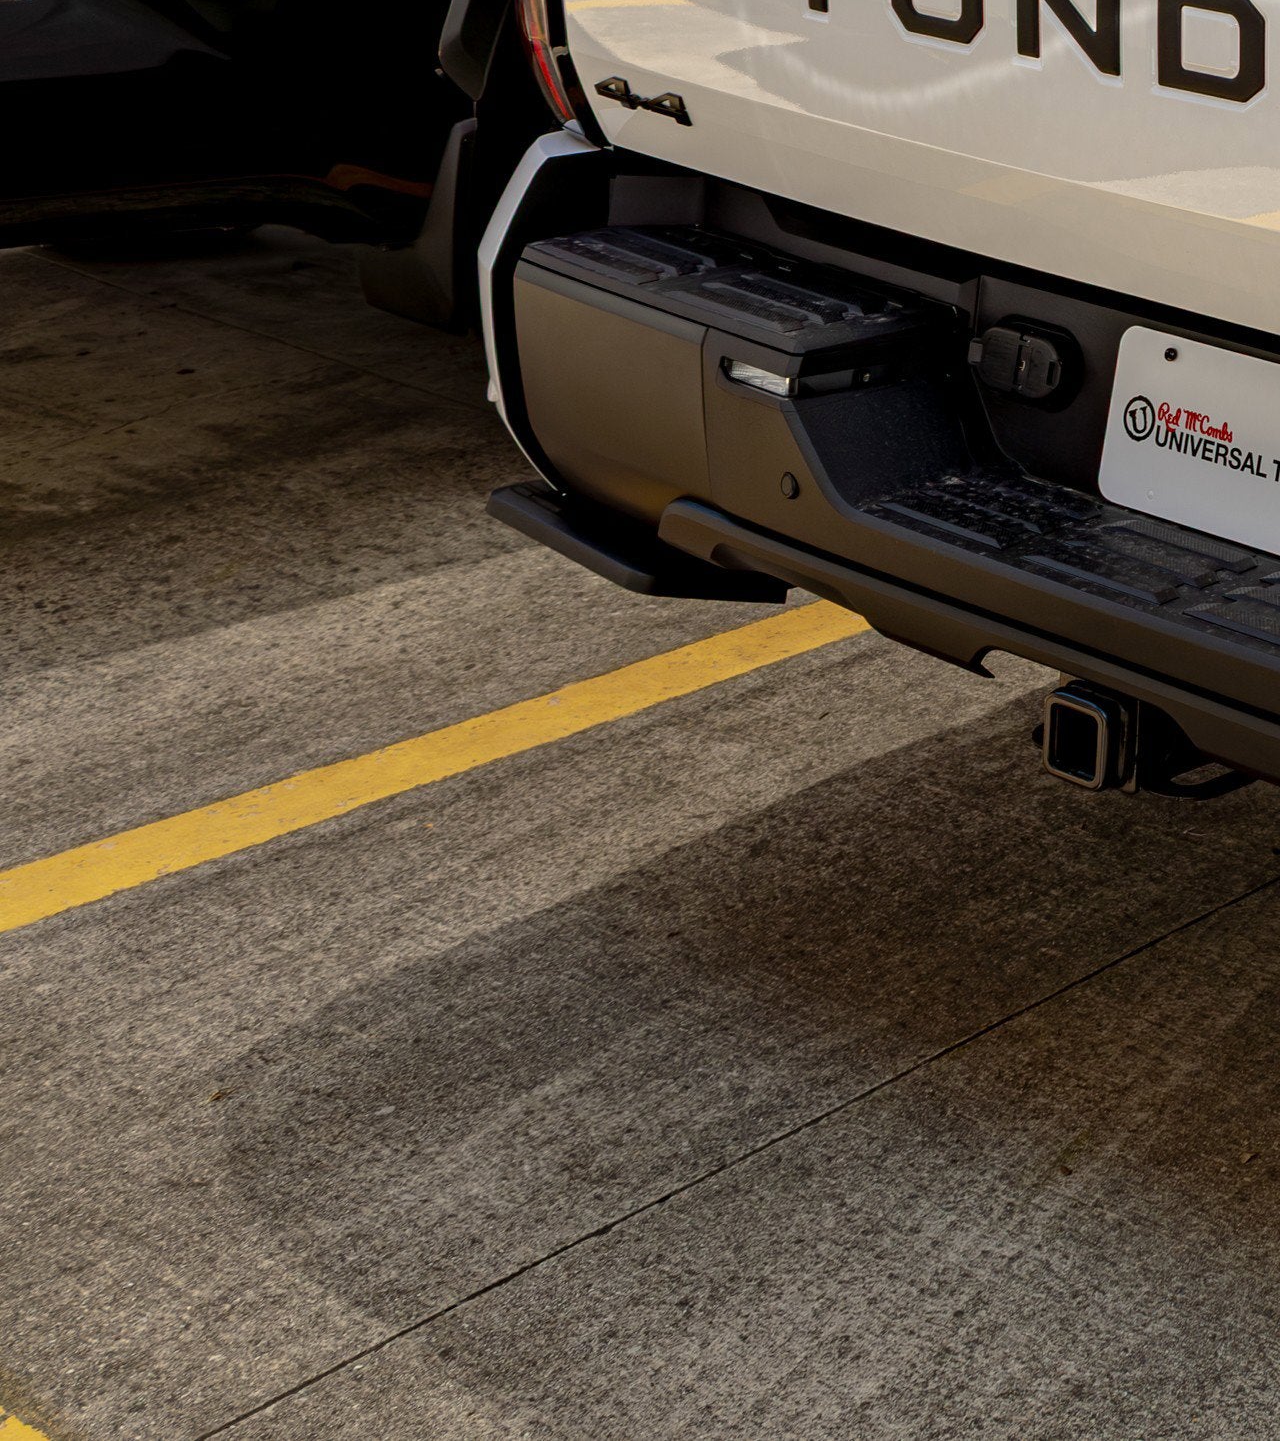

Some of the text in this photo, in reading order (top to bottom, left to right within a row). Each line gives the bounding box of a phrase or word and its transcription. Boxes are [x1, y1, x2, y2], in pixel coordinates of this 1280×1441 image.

[1157, 402, 1233, 443] Red McCombs
[1155, 425, 1267, 478] UNIVERSAL
